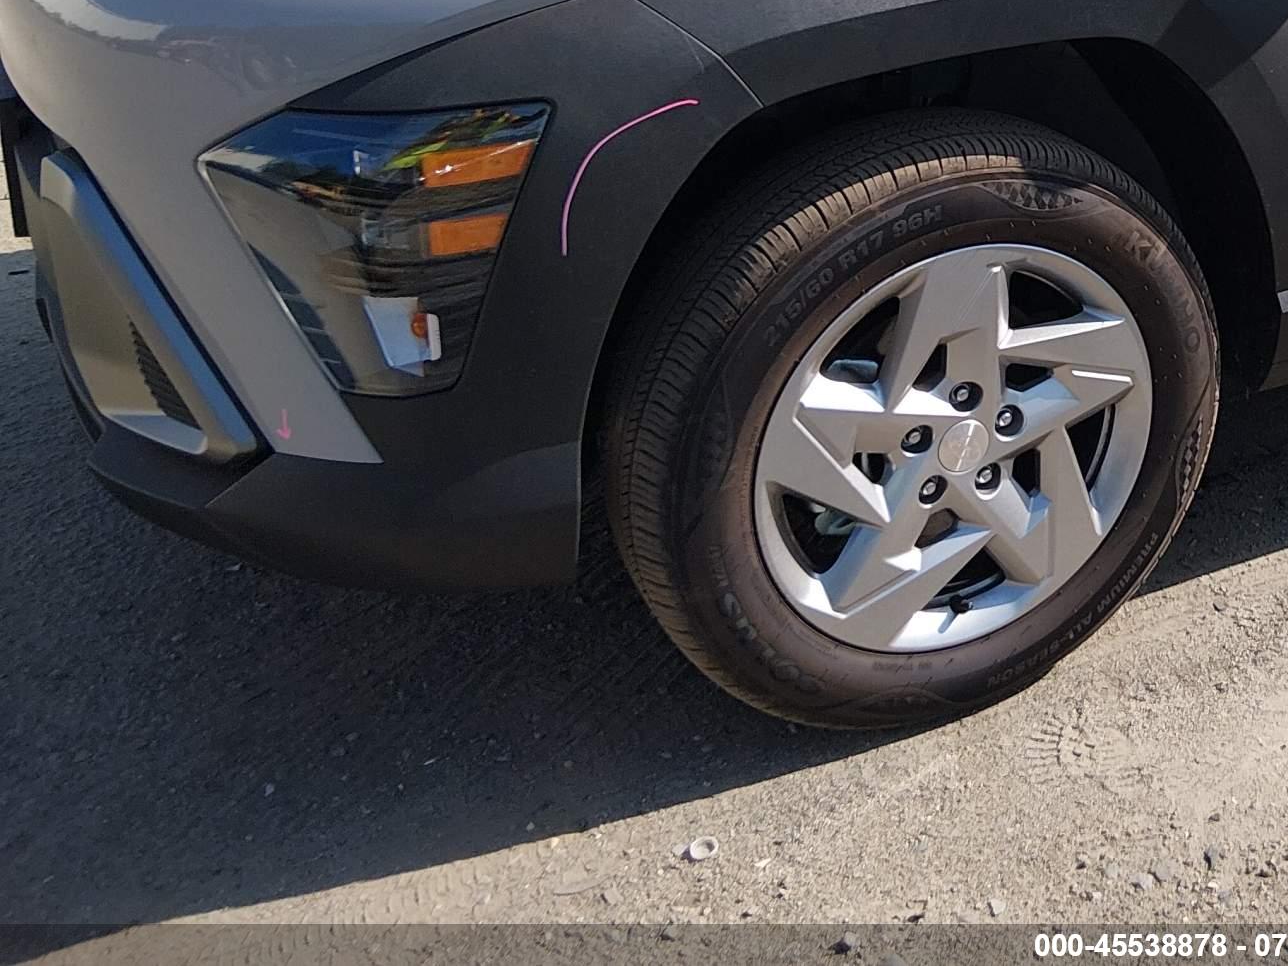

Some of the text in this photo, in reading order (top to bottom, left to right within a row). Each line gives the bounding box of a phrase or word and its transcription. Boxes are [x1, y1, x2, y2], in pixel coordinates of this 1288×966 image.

[765, 204, 943, 348] 215/60 R17 96H
[1096, 532, 1158, 613] PREMIUM
